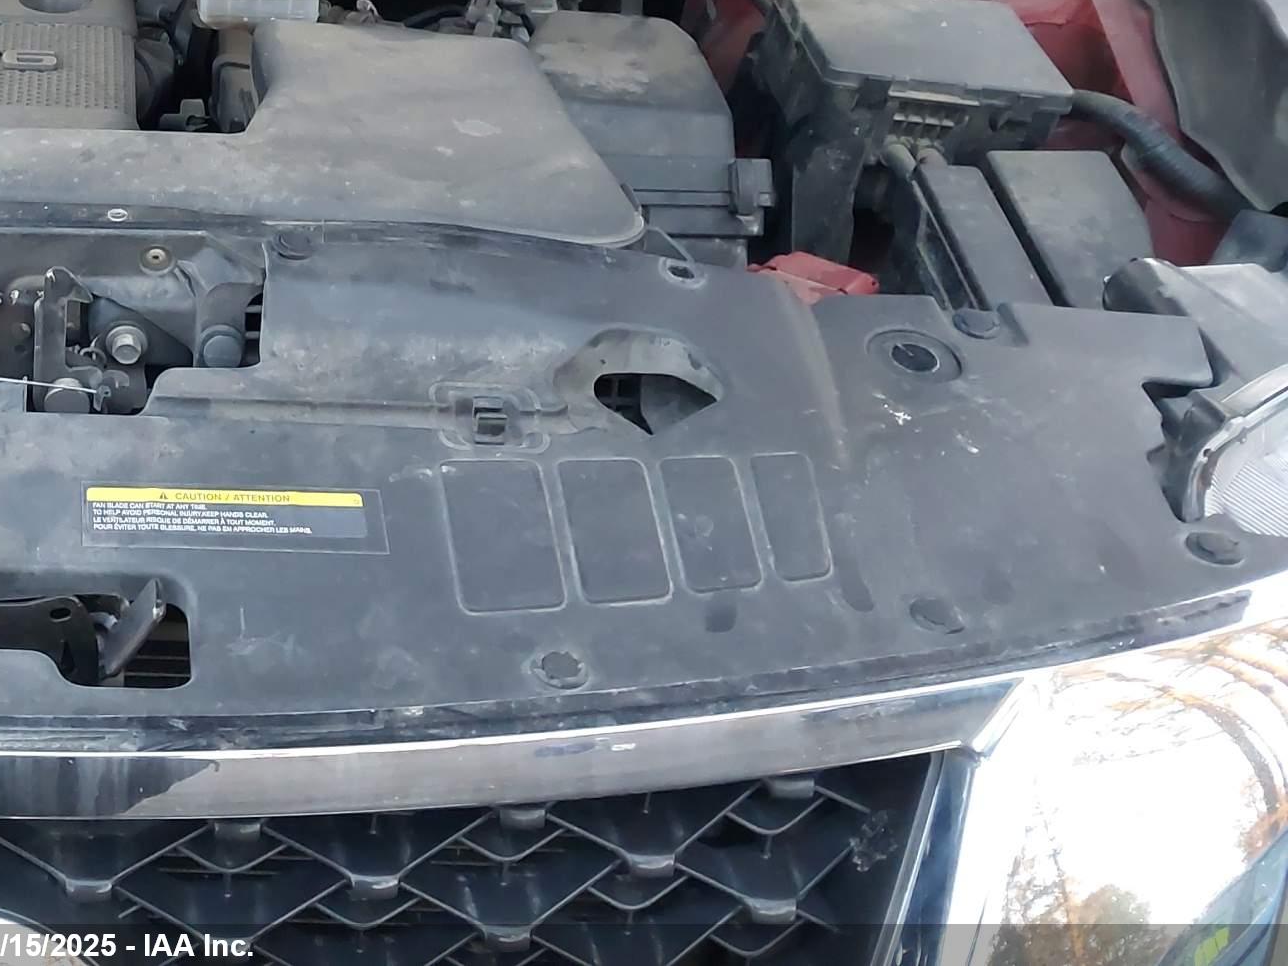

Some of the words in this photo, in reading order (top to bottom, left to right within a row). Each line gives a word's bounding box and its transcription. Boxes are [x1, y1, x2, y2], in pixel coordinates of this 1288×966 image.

[175, 492, 221, 501] CAUTION
[233, 494, 290, 502] ATTENTION
[182, 516, 220, 524] DÉMARRER
[113, 522, 137, 531] ÉVITER
